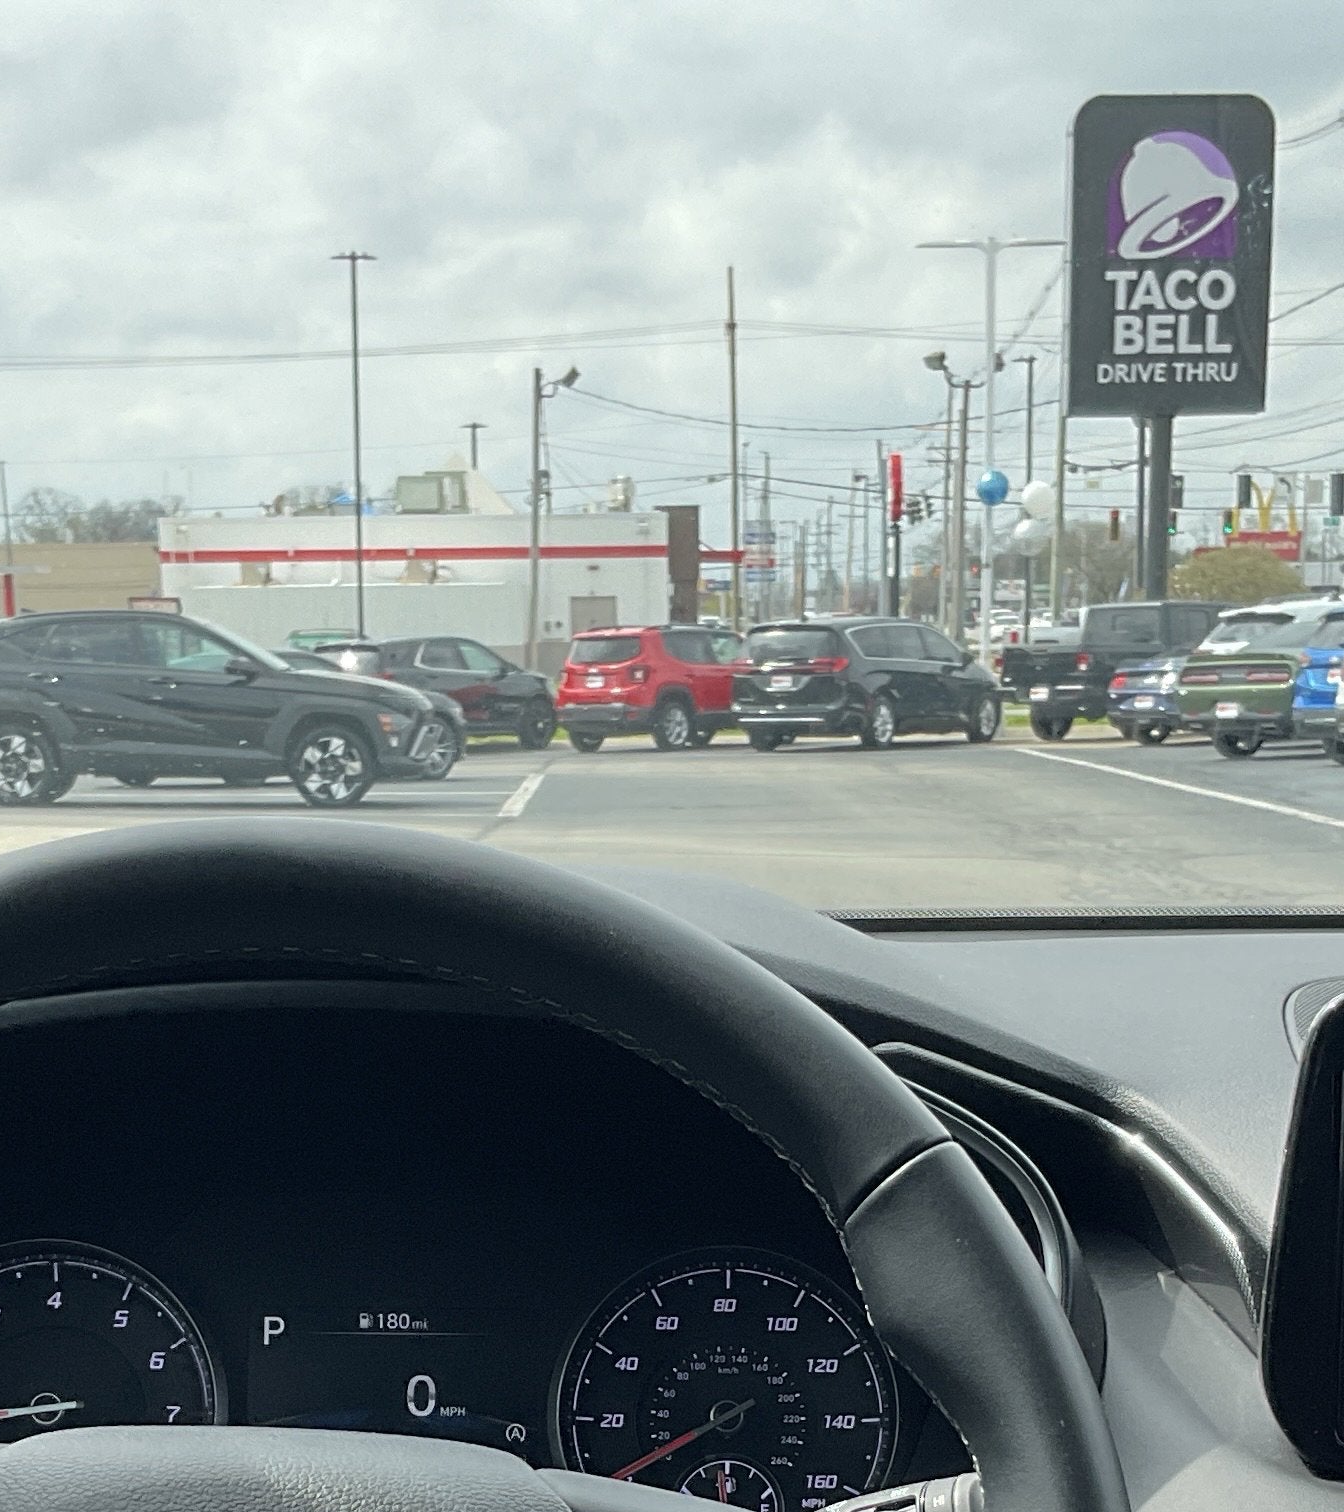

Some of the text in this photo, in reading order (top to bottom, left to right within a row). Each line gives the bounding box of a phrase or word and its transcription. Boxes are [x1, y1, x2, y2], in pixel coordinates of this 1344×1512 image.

[1104, 269, 1237, 311] TACO
[1113, 314, 1233, 355] BELL
[1096, 361, 1239, 384] DRIVE THRU
[46, 1291, 63, 1310] 4
[713, 1299, 737, 1313] 80
[113, 1309, 130, 1328] 5
[655, 1316, 680, 1331] 60
[766, 1317, 799, 1332] 100
[262, 1316, 286, 1346] P
[148, 1351, 166, 1370] 6
[614, 1357, 639, 1372] 40
[709, 1355, 727, 1363] 120
[731, 1355, 748, 1363] 140
[690, 1362, 706, 1371] 100
[717, 1366, 740, 1375] km/h
[752, 1363, 769, 1372] 160
[807, 1359, 839, 1374] 120
[676, 1372, 690, 1381] 80
[406, 1374, 467, 1418] 0 MPH
[663, 1389, 676, 1398] 60
[777, 1394, 795, 1403] 200
[165, 1405, 182, 1423] 7
[599, 1413, 625, 1428] 20
[657, 1409, 670, 1418] 40
[783, 1415, 800, 1423] 220
[824, 1415, 856, 1430] 140
[658, 1431, 671, 1441] 20
[780, 1436, 798, 1444] 240
[770, 1456, 788, 1465] 260
[806, 1475, 838, 1489] 160
[801, 1498, 827, 1510] MPH
[932, 1494, 946, 1507] HI
